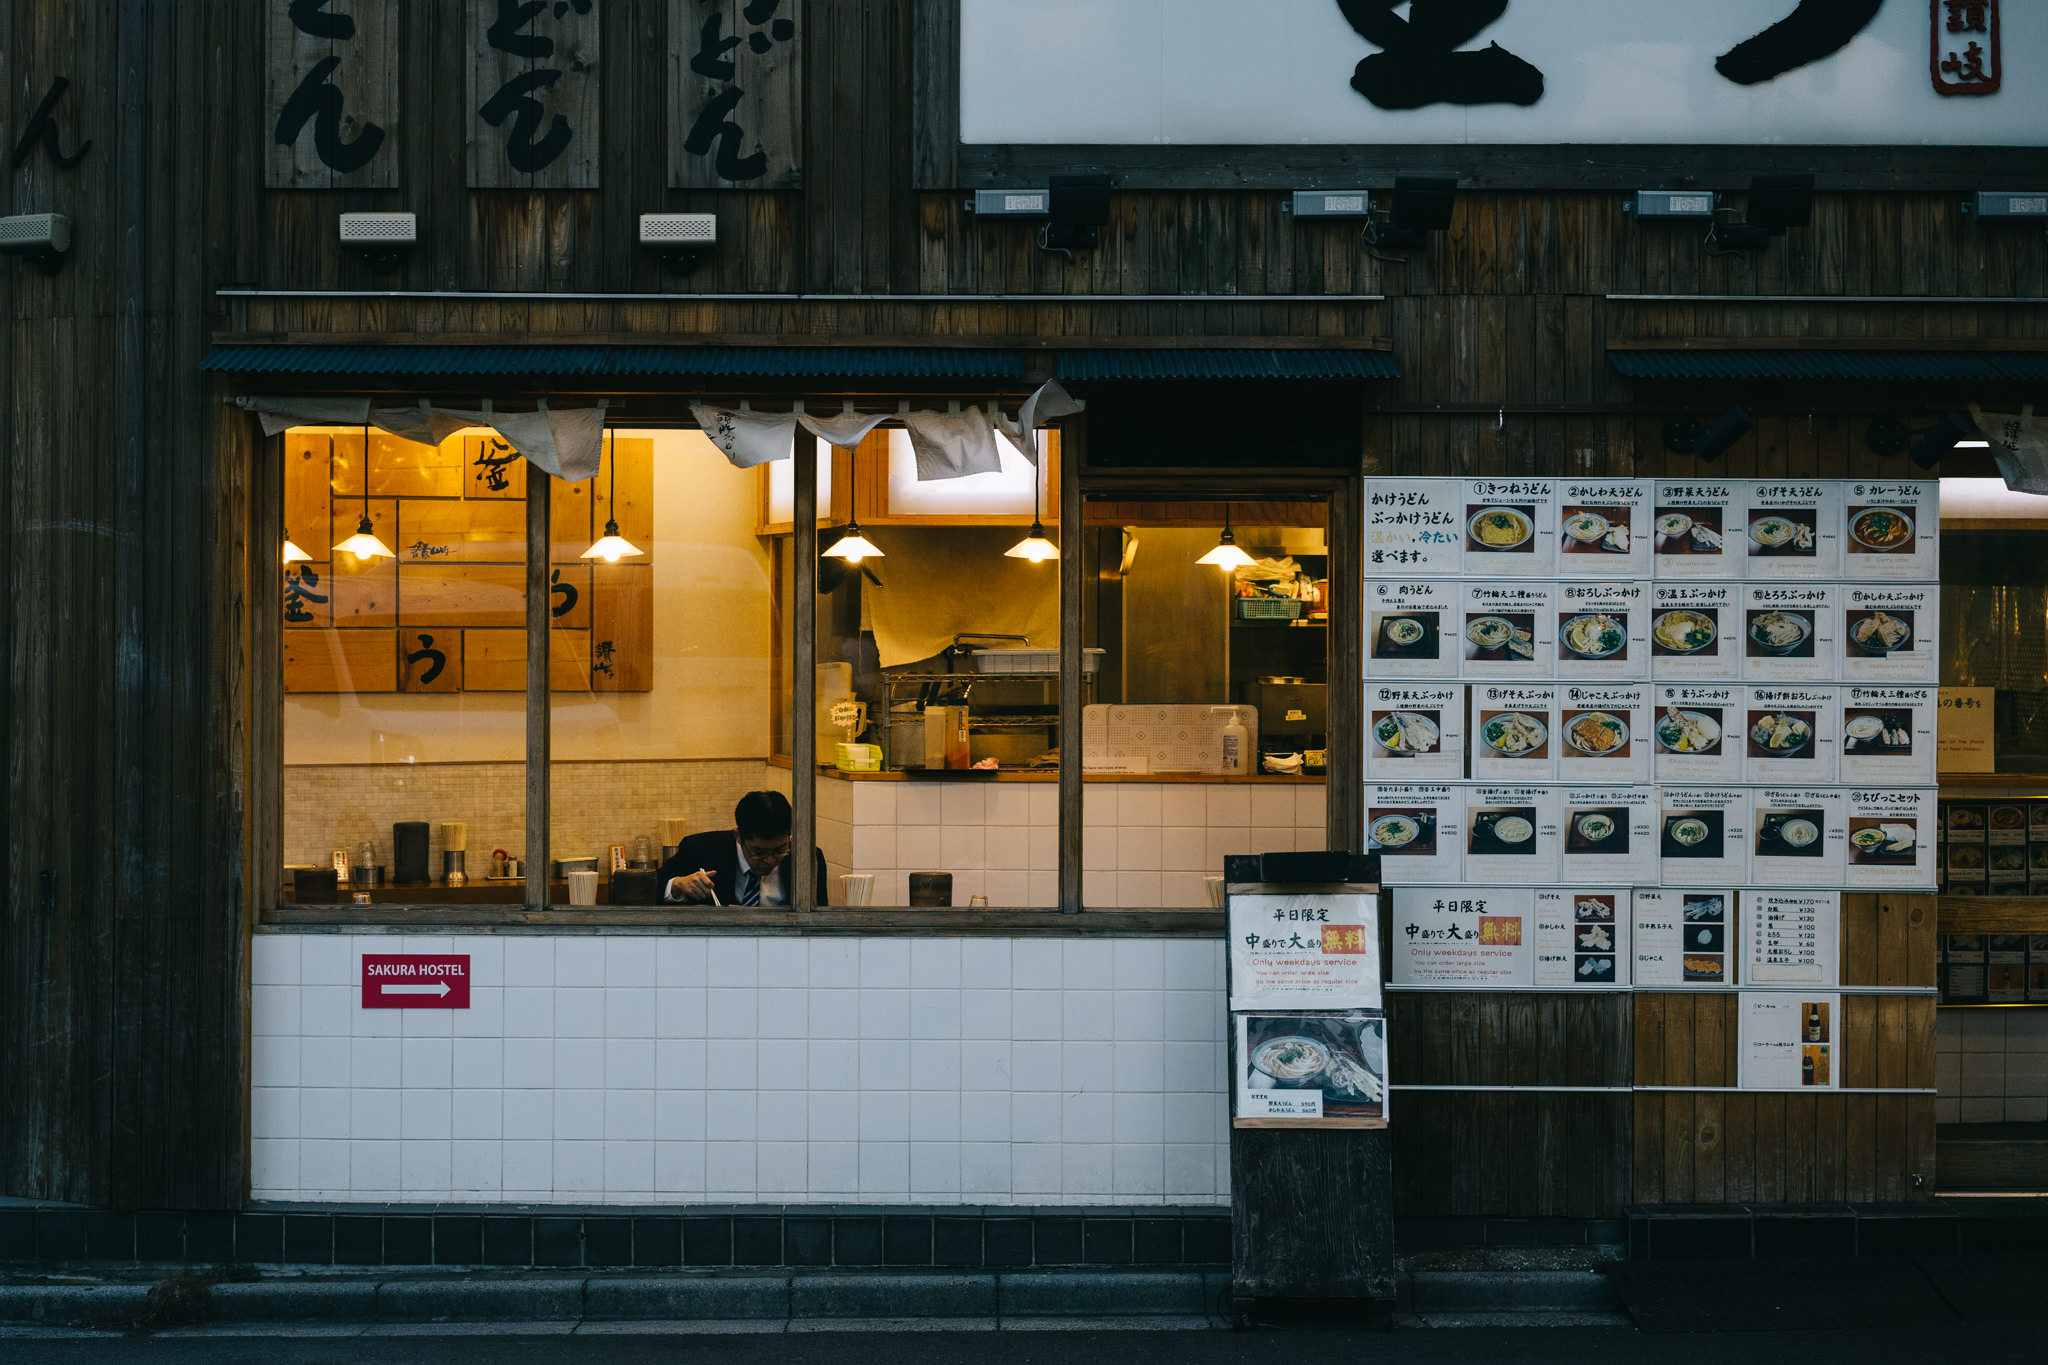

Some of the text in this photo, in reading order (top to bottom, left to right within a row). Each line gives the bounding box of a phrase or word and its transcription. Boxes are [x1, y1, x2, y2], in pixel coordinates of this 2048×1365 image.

[1371, 492, 1430, 506] かけうどん
[1371, 511, 1454, 525] ぶっかけうどん
[1371, 550, 1428, 563] 選べます。
[1399, 585, 1433, 595] 肉うどん
[407, 634, 446, 684] う
[1433, 900, 1488, 913] 平日限定
[1273, 908, 1330, 922] 平日限定
[1405, 921, 1520, 942] 中盛りで大盛り 無料
[1245, 928, 1364, 950] 中盛りで大盛り 無料
[1411, 948, 1512, 957] Only weekdays service
[368, 964, 465, 976] SAKURA HOSTEL
